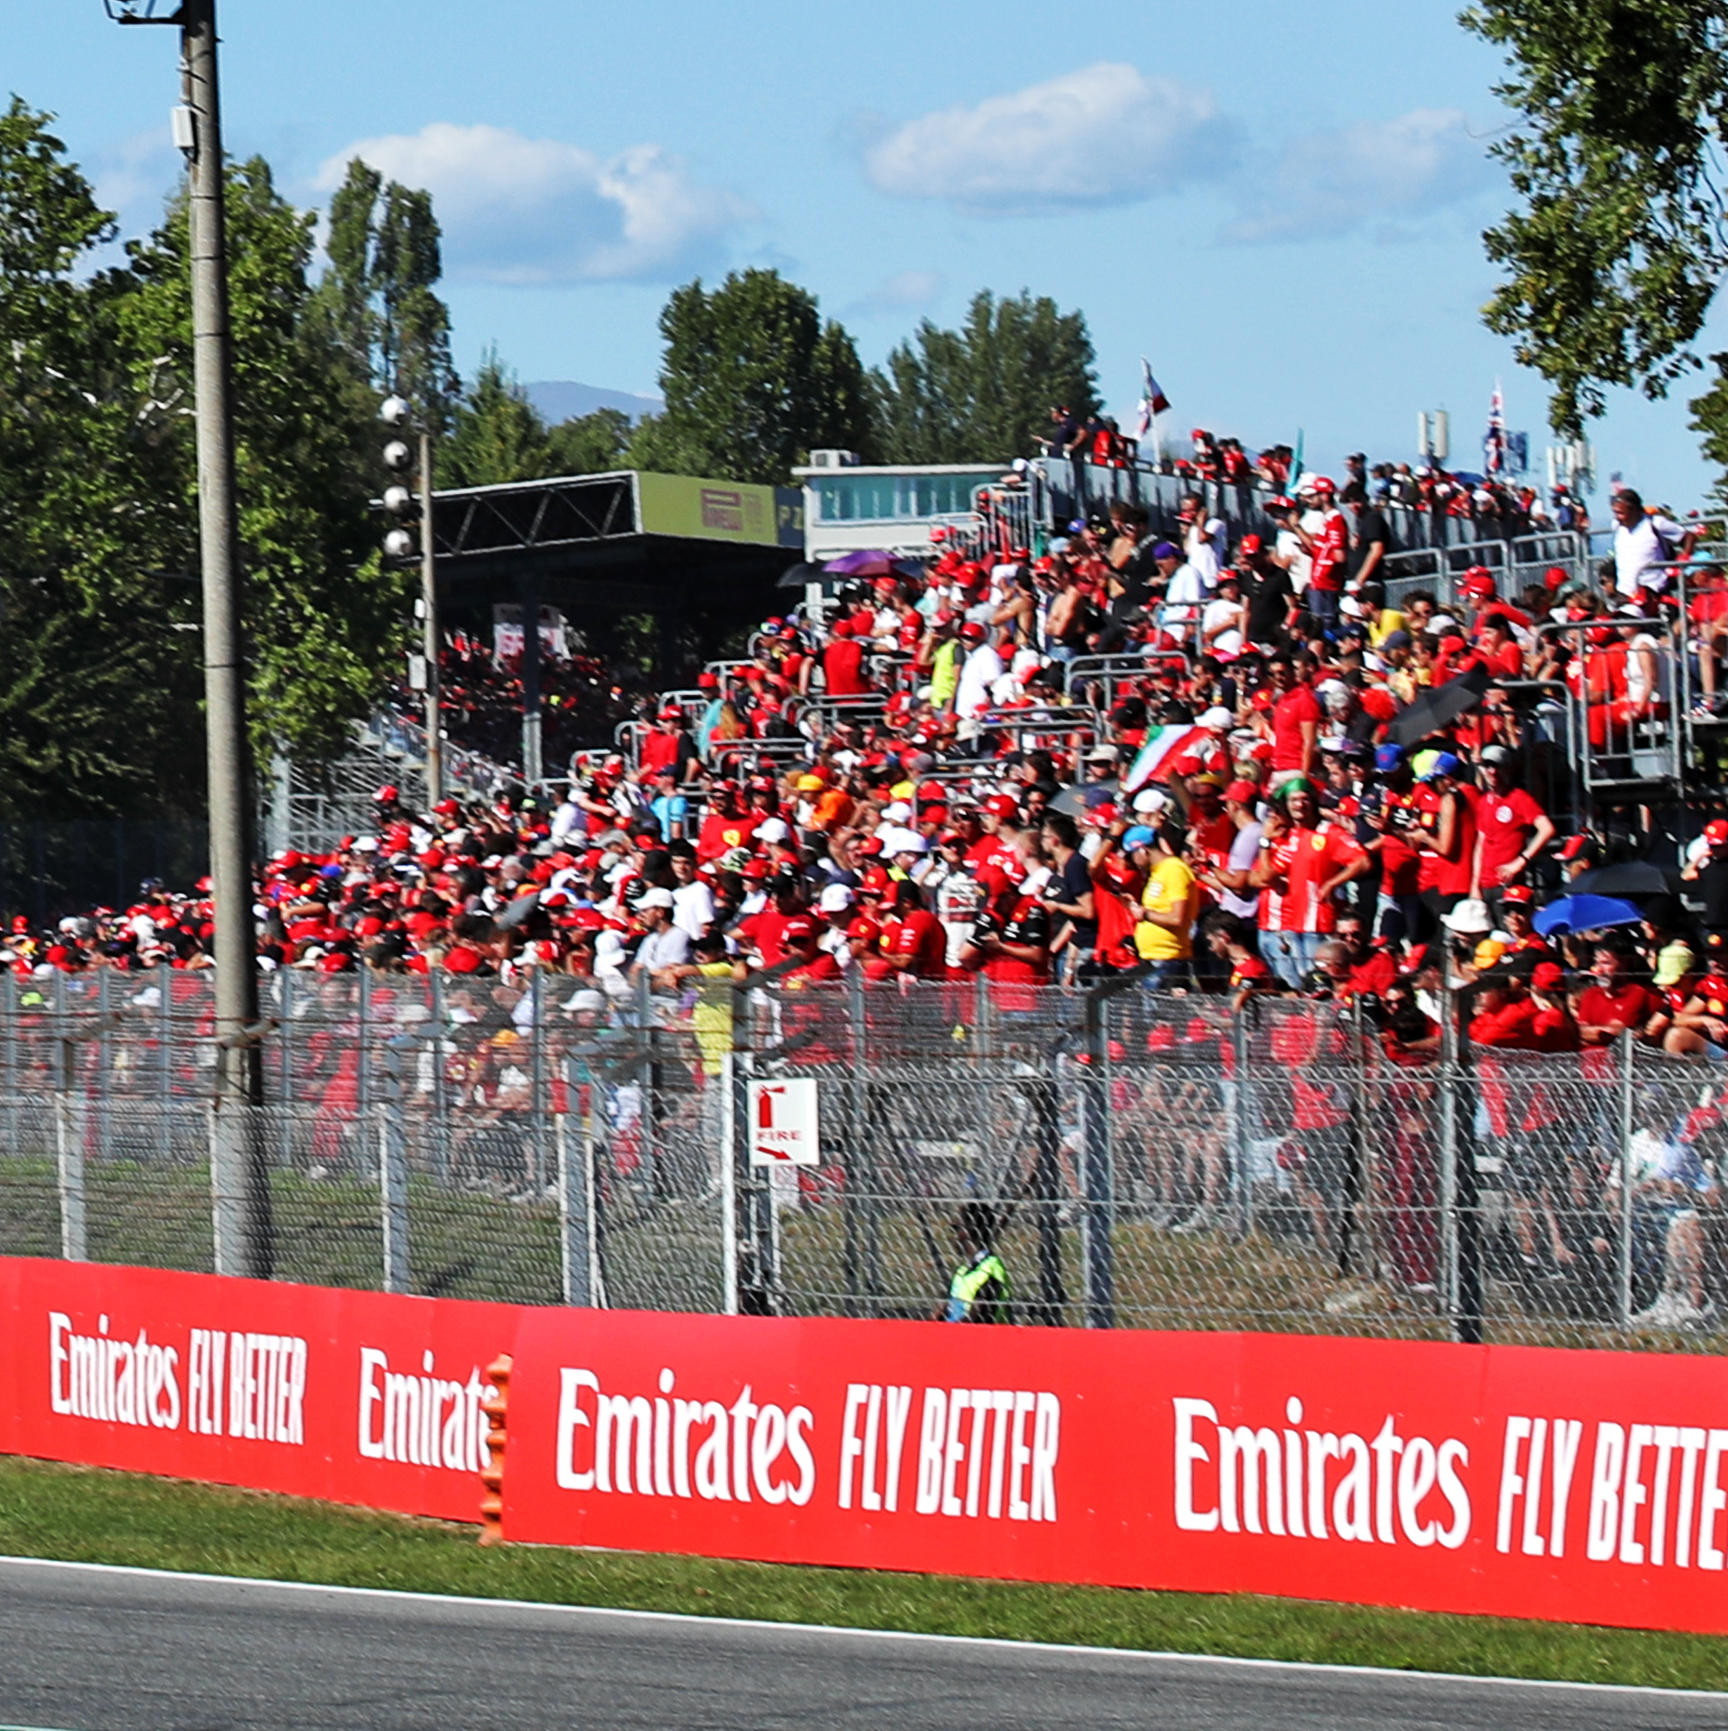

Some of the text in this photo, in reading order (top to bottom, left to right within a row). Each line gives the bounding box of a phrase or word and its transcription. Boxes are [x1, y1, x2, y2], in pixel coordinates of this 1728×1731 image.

[756, 1130, 801, 1142] FIRE
[49, 1311, 308, 1446] Emirates FLY BETTER
[357, 1346, 501, 1473] Emirate
[555, 1367, 1060, 1523] Emirates FLY BETTER
[1172, 1395, 1728, 1570] Emirates FLY BETTE
